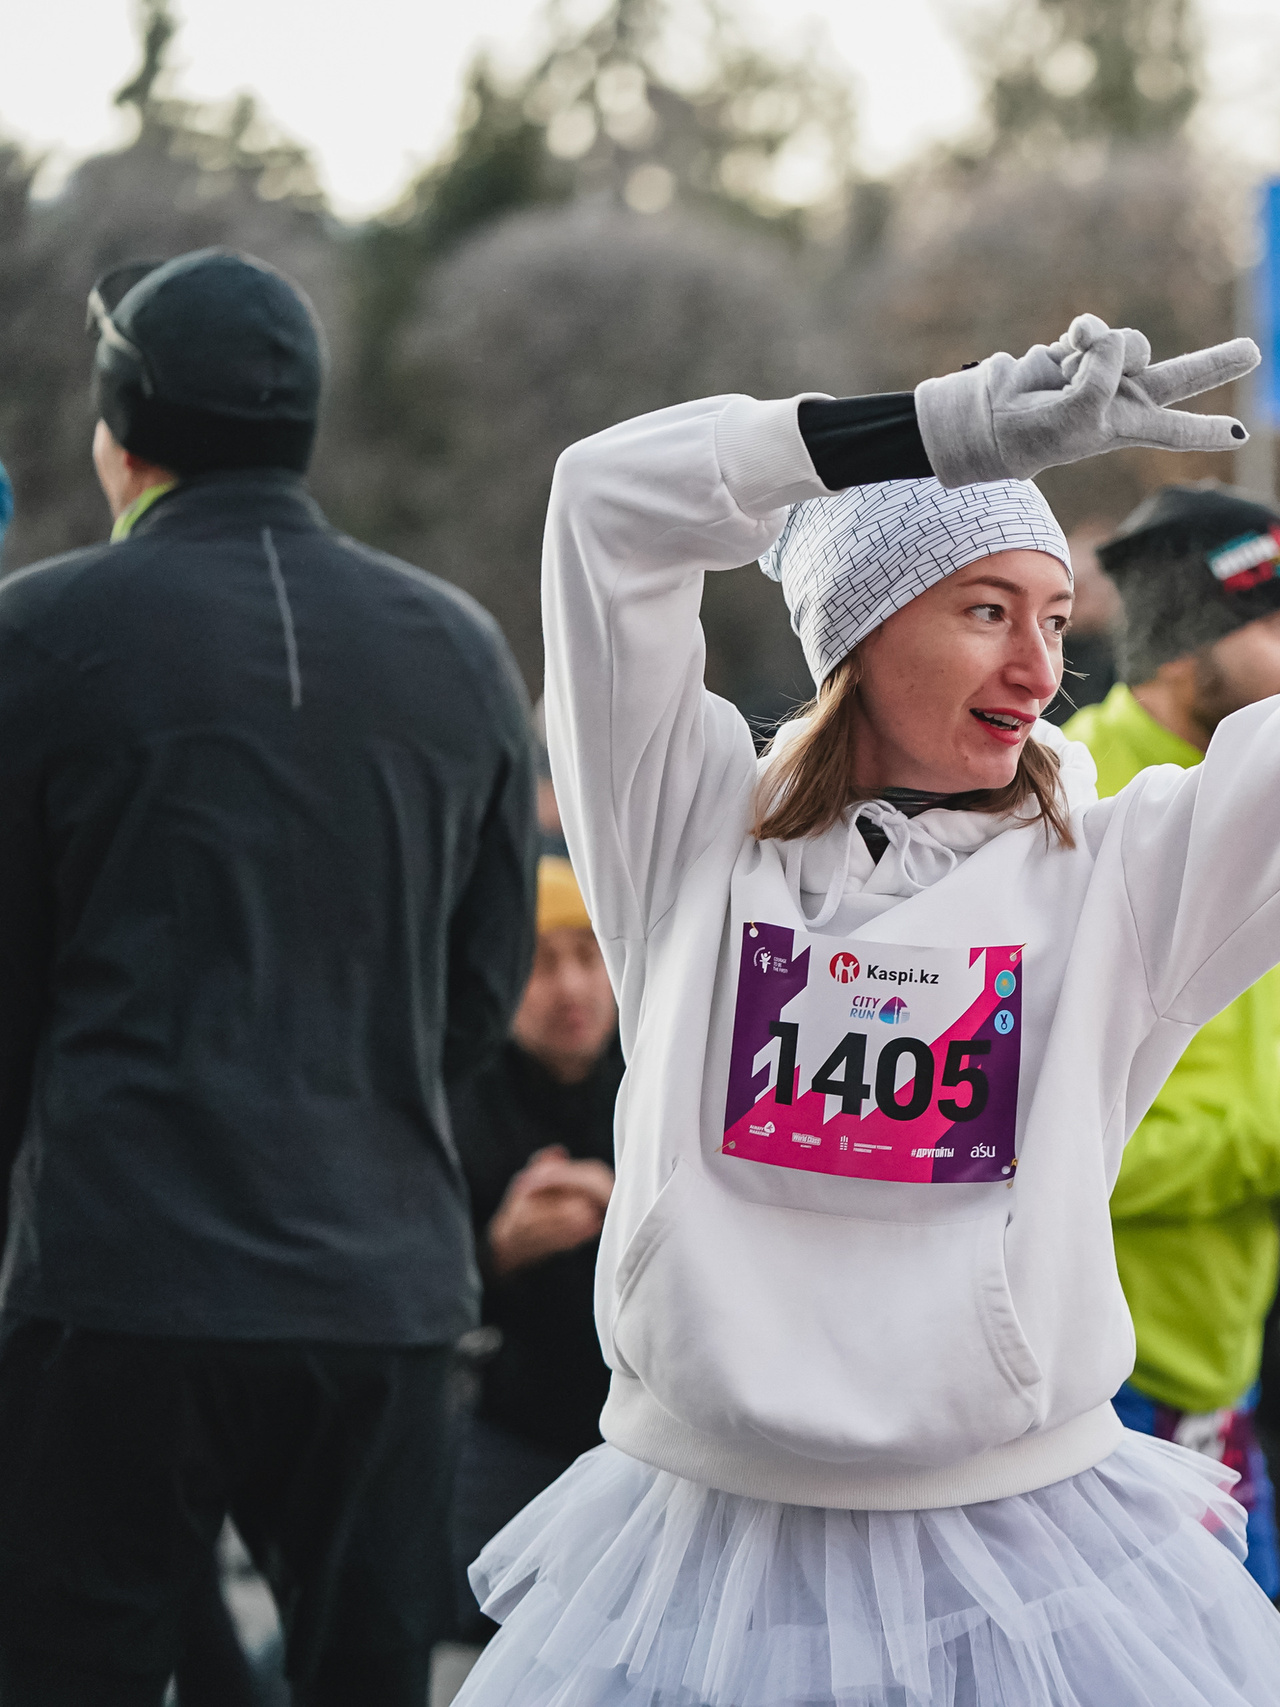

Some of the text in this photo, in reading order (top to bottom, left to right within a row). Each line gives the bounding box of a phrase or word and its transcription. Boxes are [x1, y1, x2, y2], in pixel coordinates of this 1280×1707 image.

[867, 964, 939, 985] Kaspi.kz
[852, 995, 881, 1009] CITY
[849, 1007, 875, 1020] RUN
[769, 1020, 991, 1122] 1405
